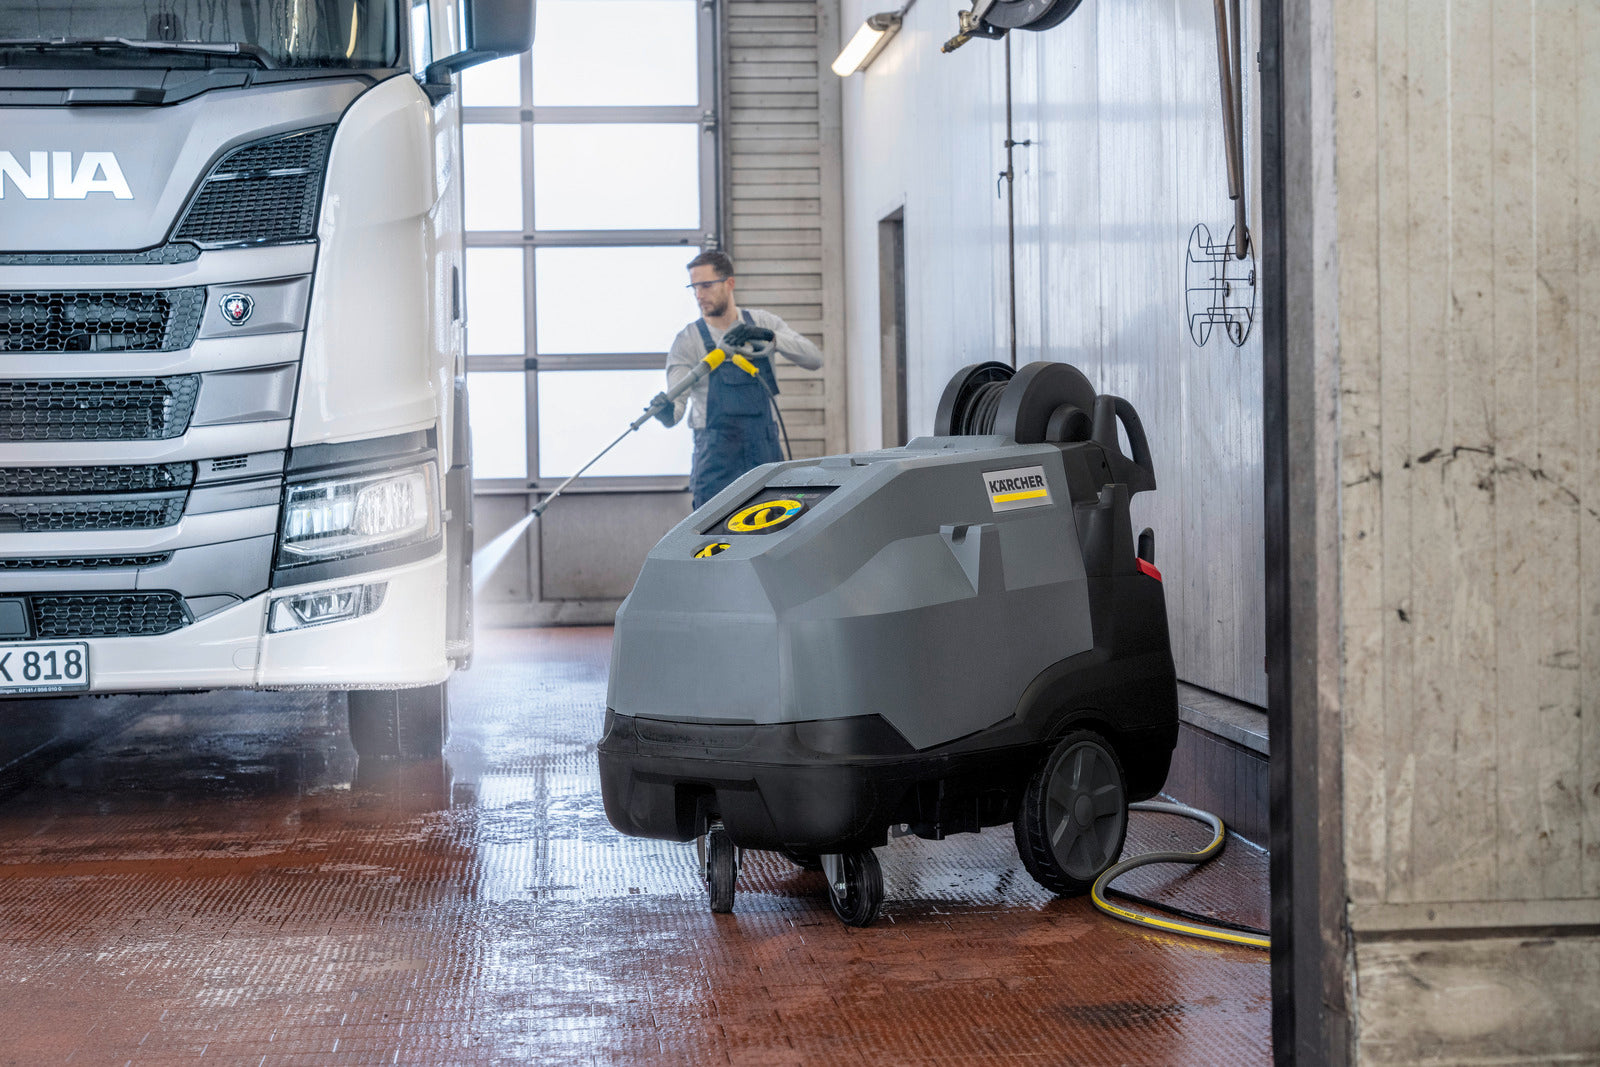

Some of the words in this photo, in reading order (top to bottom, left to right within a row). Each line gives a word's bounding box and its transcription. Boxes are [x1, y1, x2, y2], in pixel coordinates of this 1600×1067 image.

[0, 151, 134, 199] NIA
[989, 475, 1045, 493] KÄRCHER
[23, 649, 82, 680] 818
